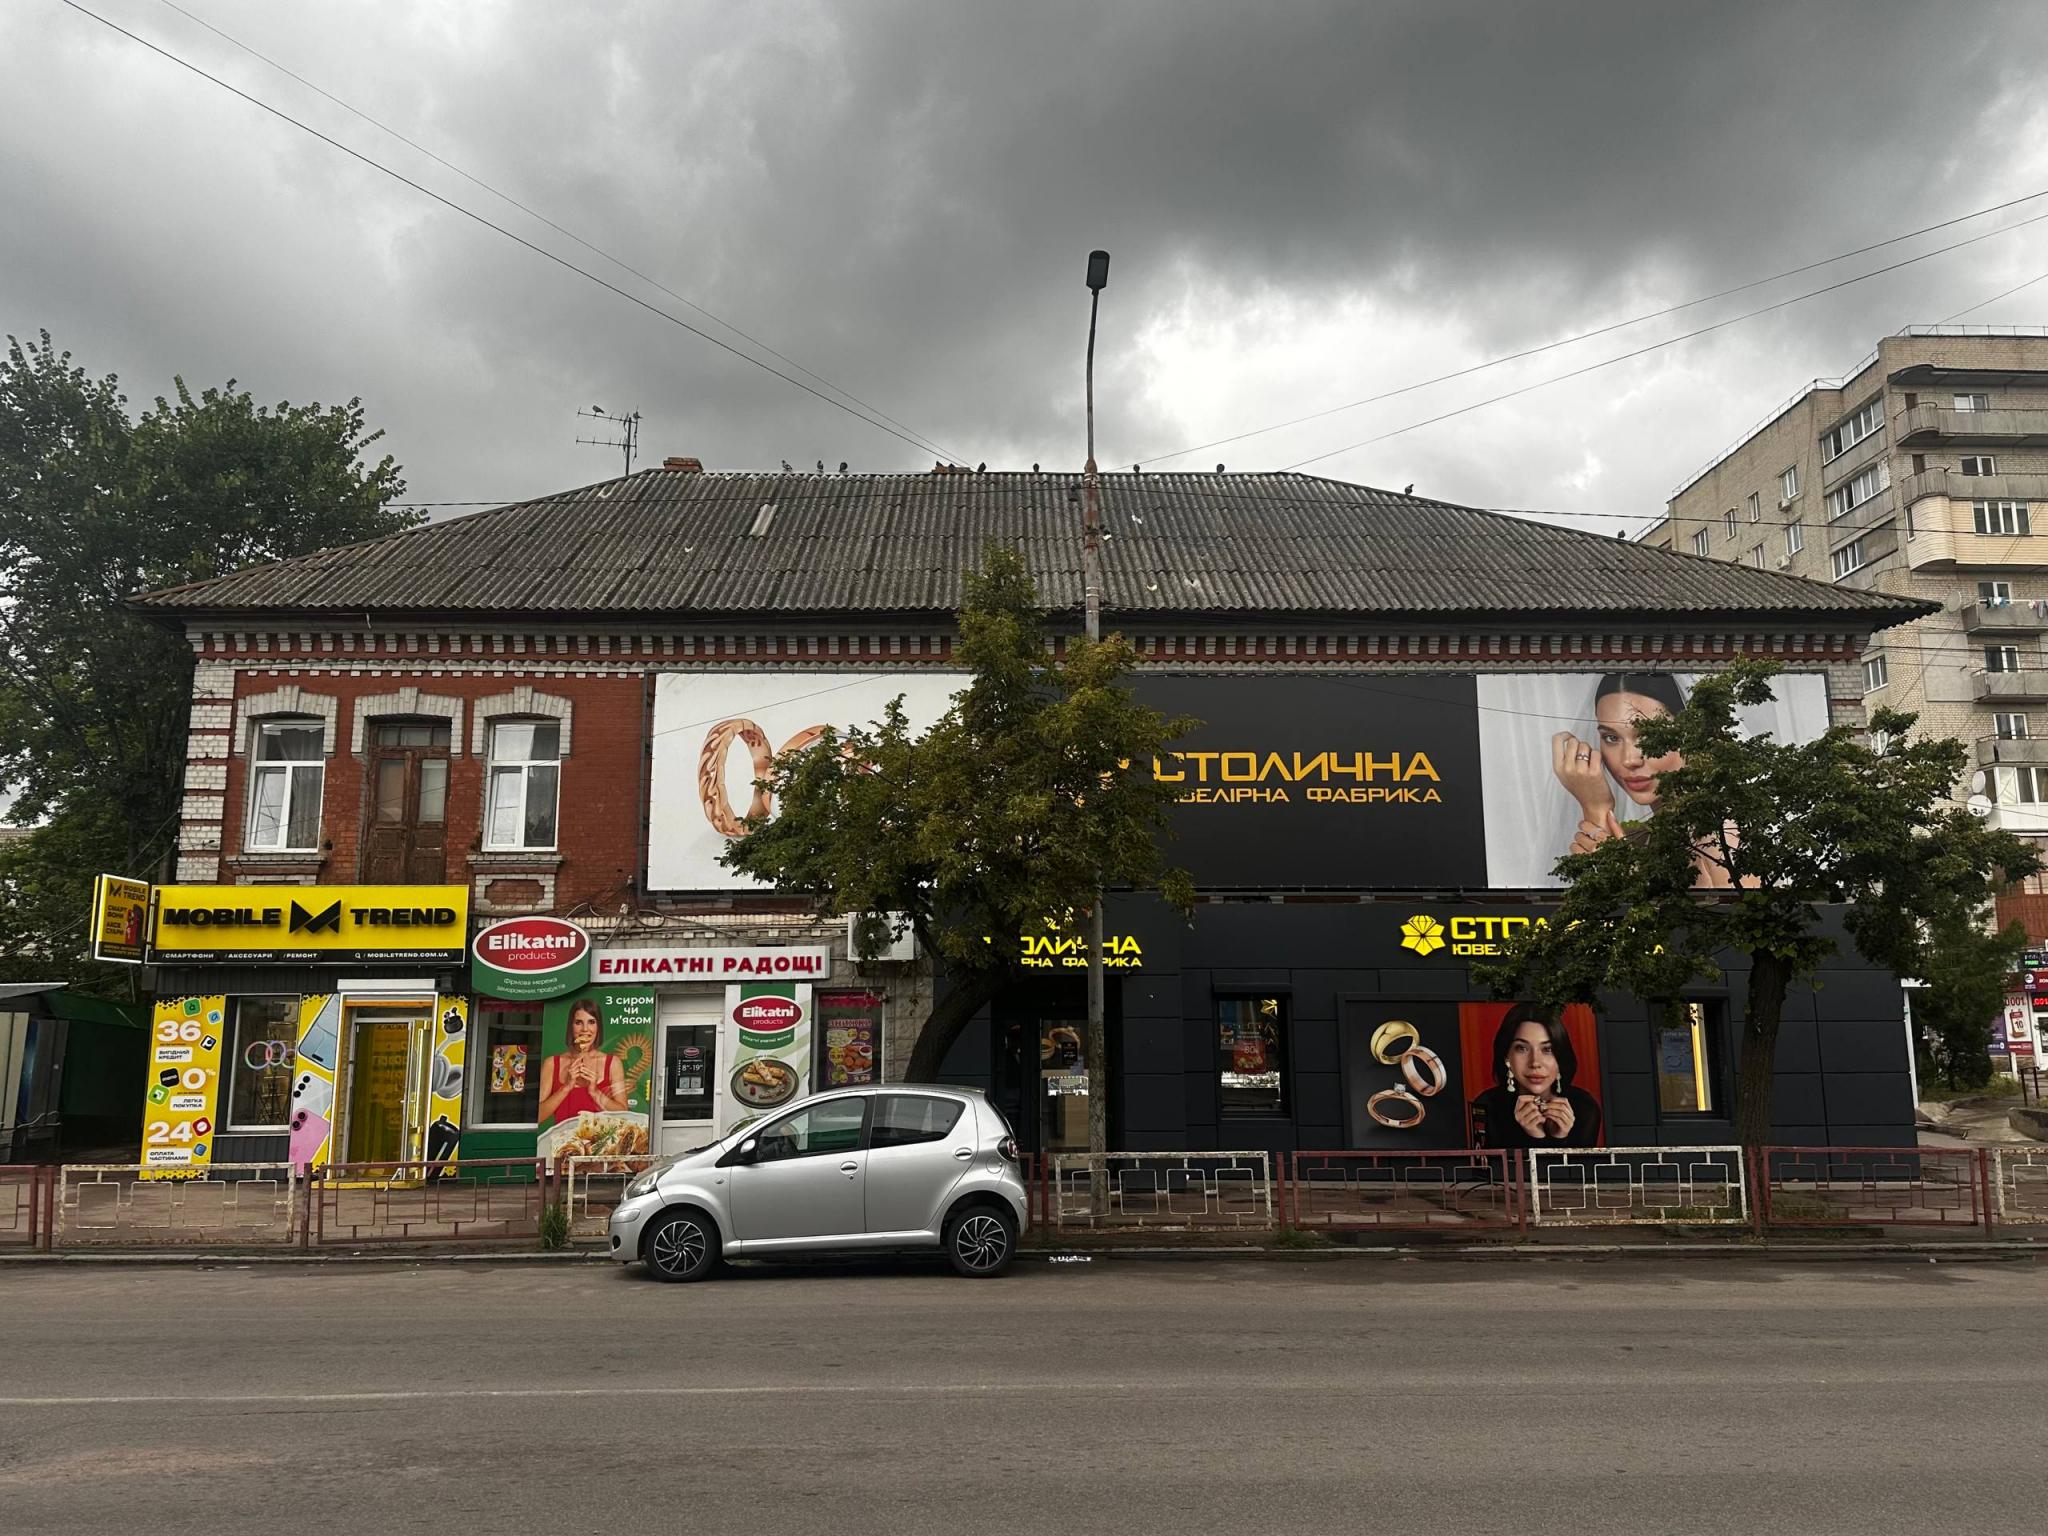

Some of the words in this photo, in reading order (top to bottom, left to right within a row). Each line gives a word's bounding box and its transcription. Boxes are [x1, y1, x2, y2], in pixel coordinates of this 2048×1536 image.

[1153, 751, 1441, 782] СТОЛИЧНА
[1176, 787, 1290, 803] ВЕЛІРНА
[1306, 787, 1442, 803] ФАБРИКА
[163, 908, 282, 926] MOBILE
[350, 908, 456, 926] TREND
[488, 930, 577, 950] Elikatni
[1020, 935, 1142, 955] ОЛИНА
[508, 950, 557, 962] products
[599, 957, 714, 974] ЕЛІКАТНІ
[723, 955, 822, 974] РАДОЩІ
[1062, 956, 1142, 968] ФАРИКА
[615, 996, 654, 1006] сиром
[610, 1015, 651, 1025] м'ясом
[742, 1005, 794, 1018] Elikatni
[752, 1018, 784, 1026] products
[157, 1020, 201, 1042] 36
[148, 1121, 193, 1143] 24
